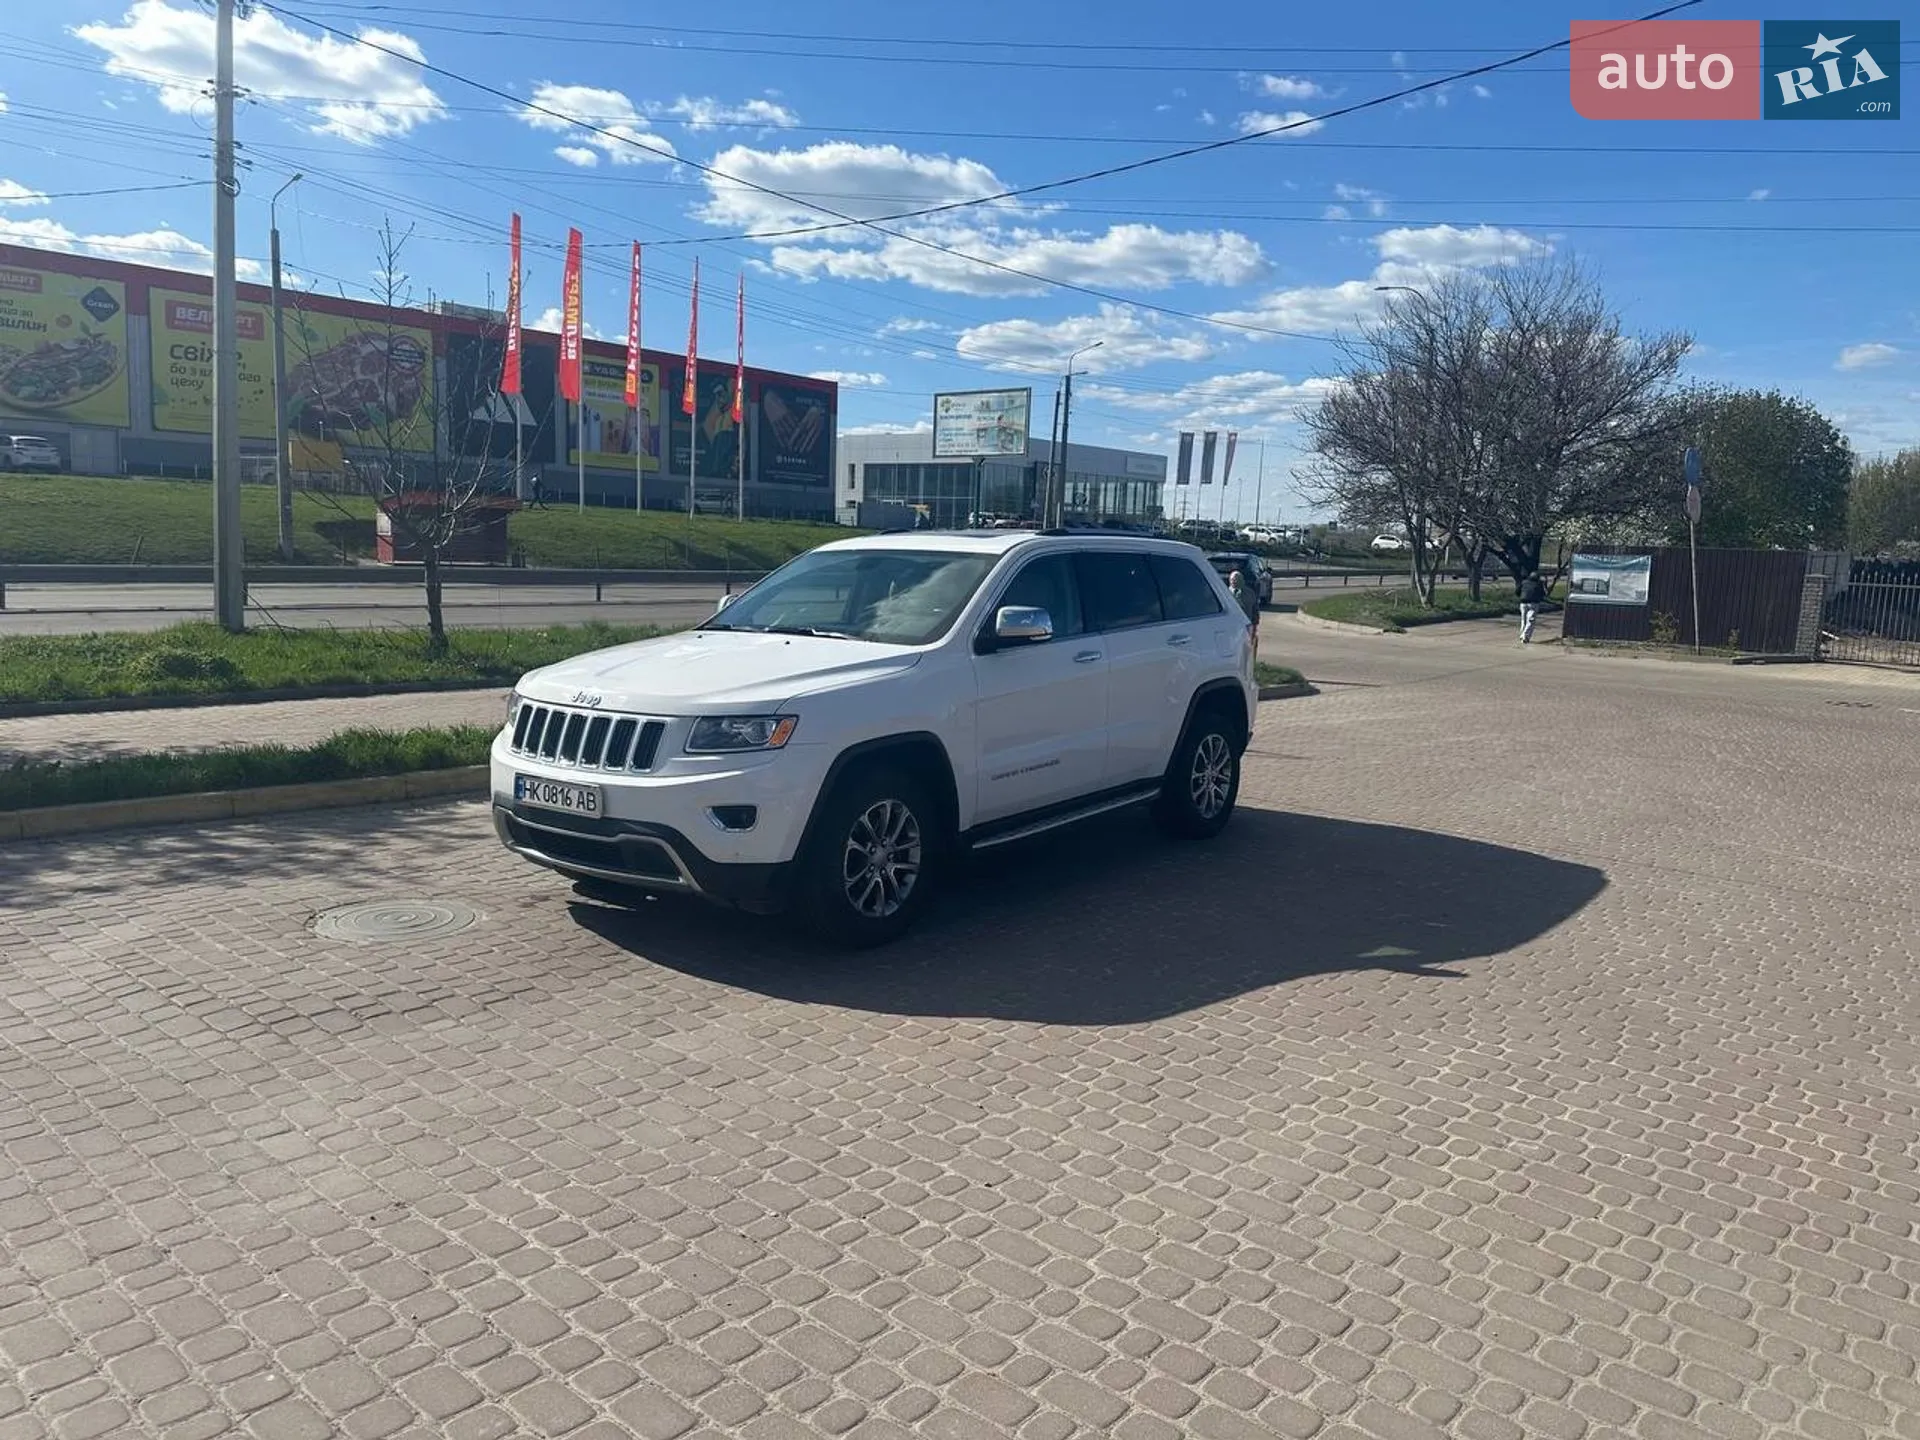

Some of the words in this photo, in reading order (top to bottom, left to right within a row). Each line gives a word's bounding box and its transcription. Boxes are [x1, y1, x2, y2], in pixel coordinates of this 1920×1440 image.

[175, 306, 256, 329] ВЕЛРТ
[523, 779, 541, 802] HK
[543, 784, 573, 807] 0816
[576, 790, 597, 812] AB
